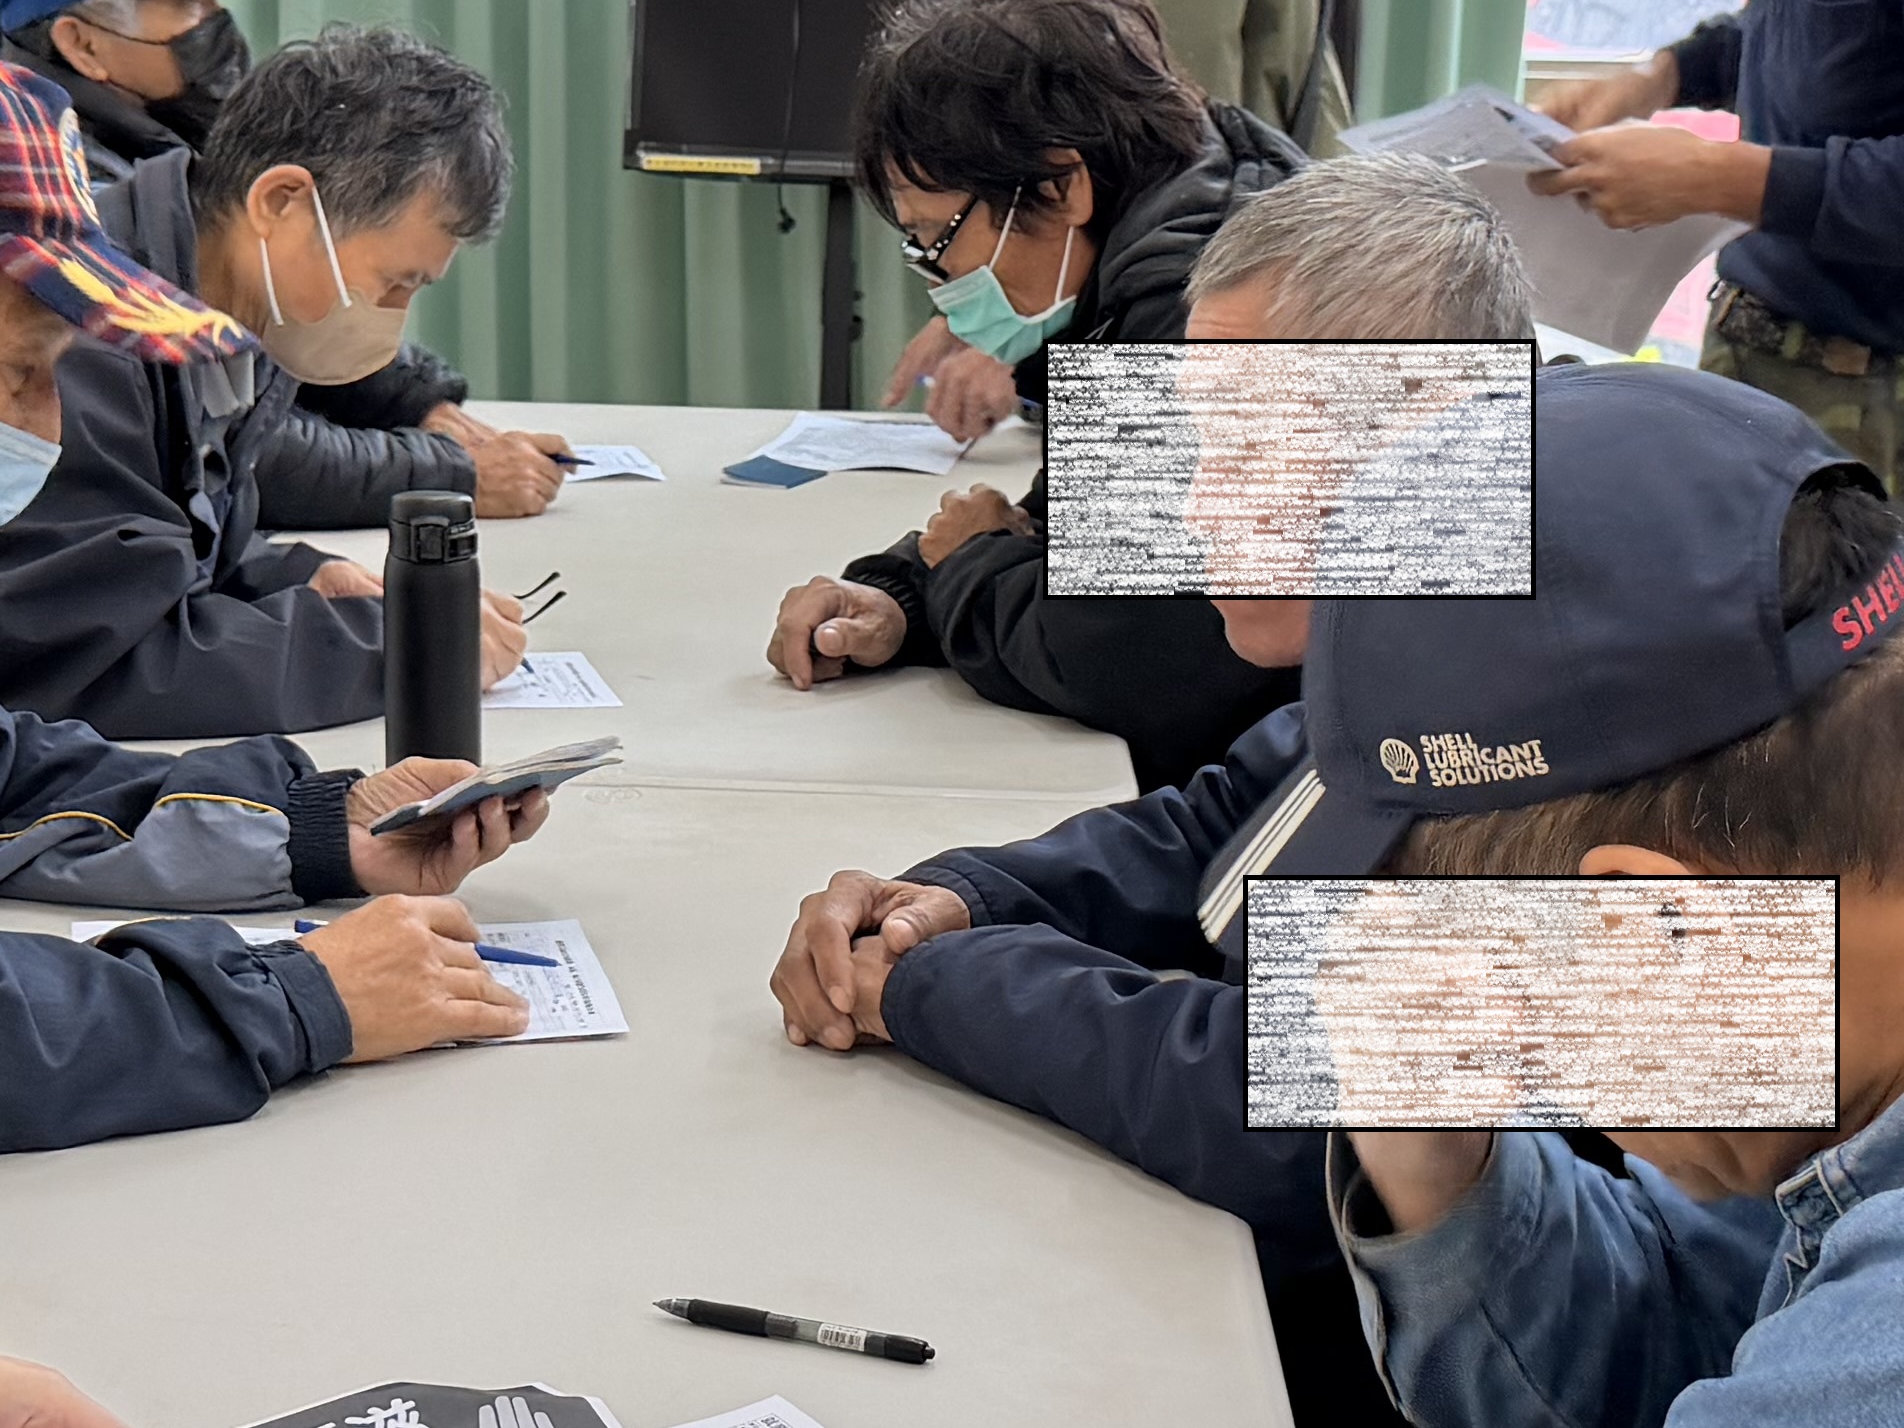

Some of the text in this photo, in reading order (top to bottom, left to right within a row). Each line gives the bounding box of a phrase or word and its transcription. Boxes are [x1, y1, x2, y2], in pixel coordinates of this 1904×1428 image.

[1420, 732, 1477, 752] SHELL
[1424, 739, 1542, 771] LUBRICANT
[1429, 756, 1550, 787] SOLUTIONS
